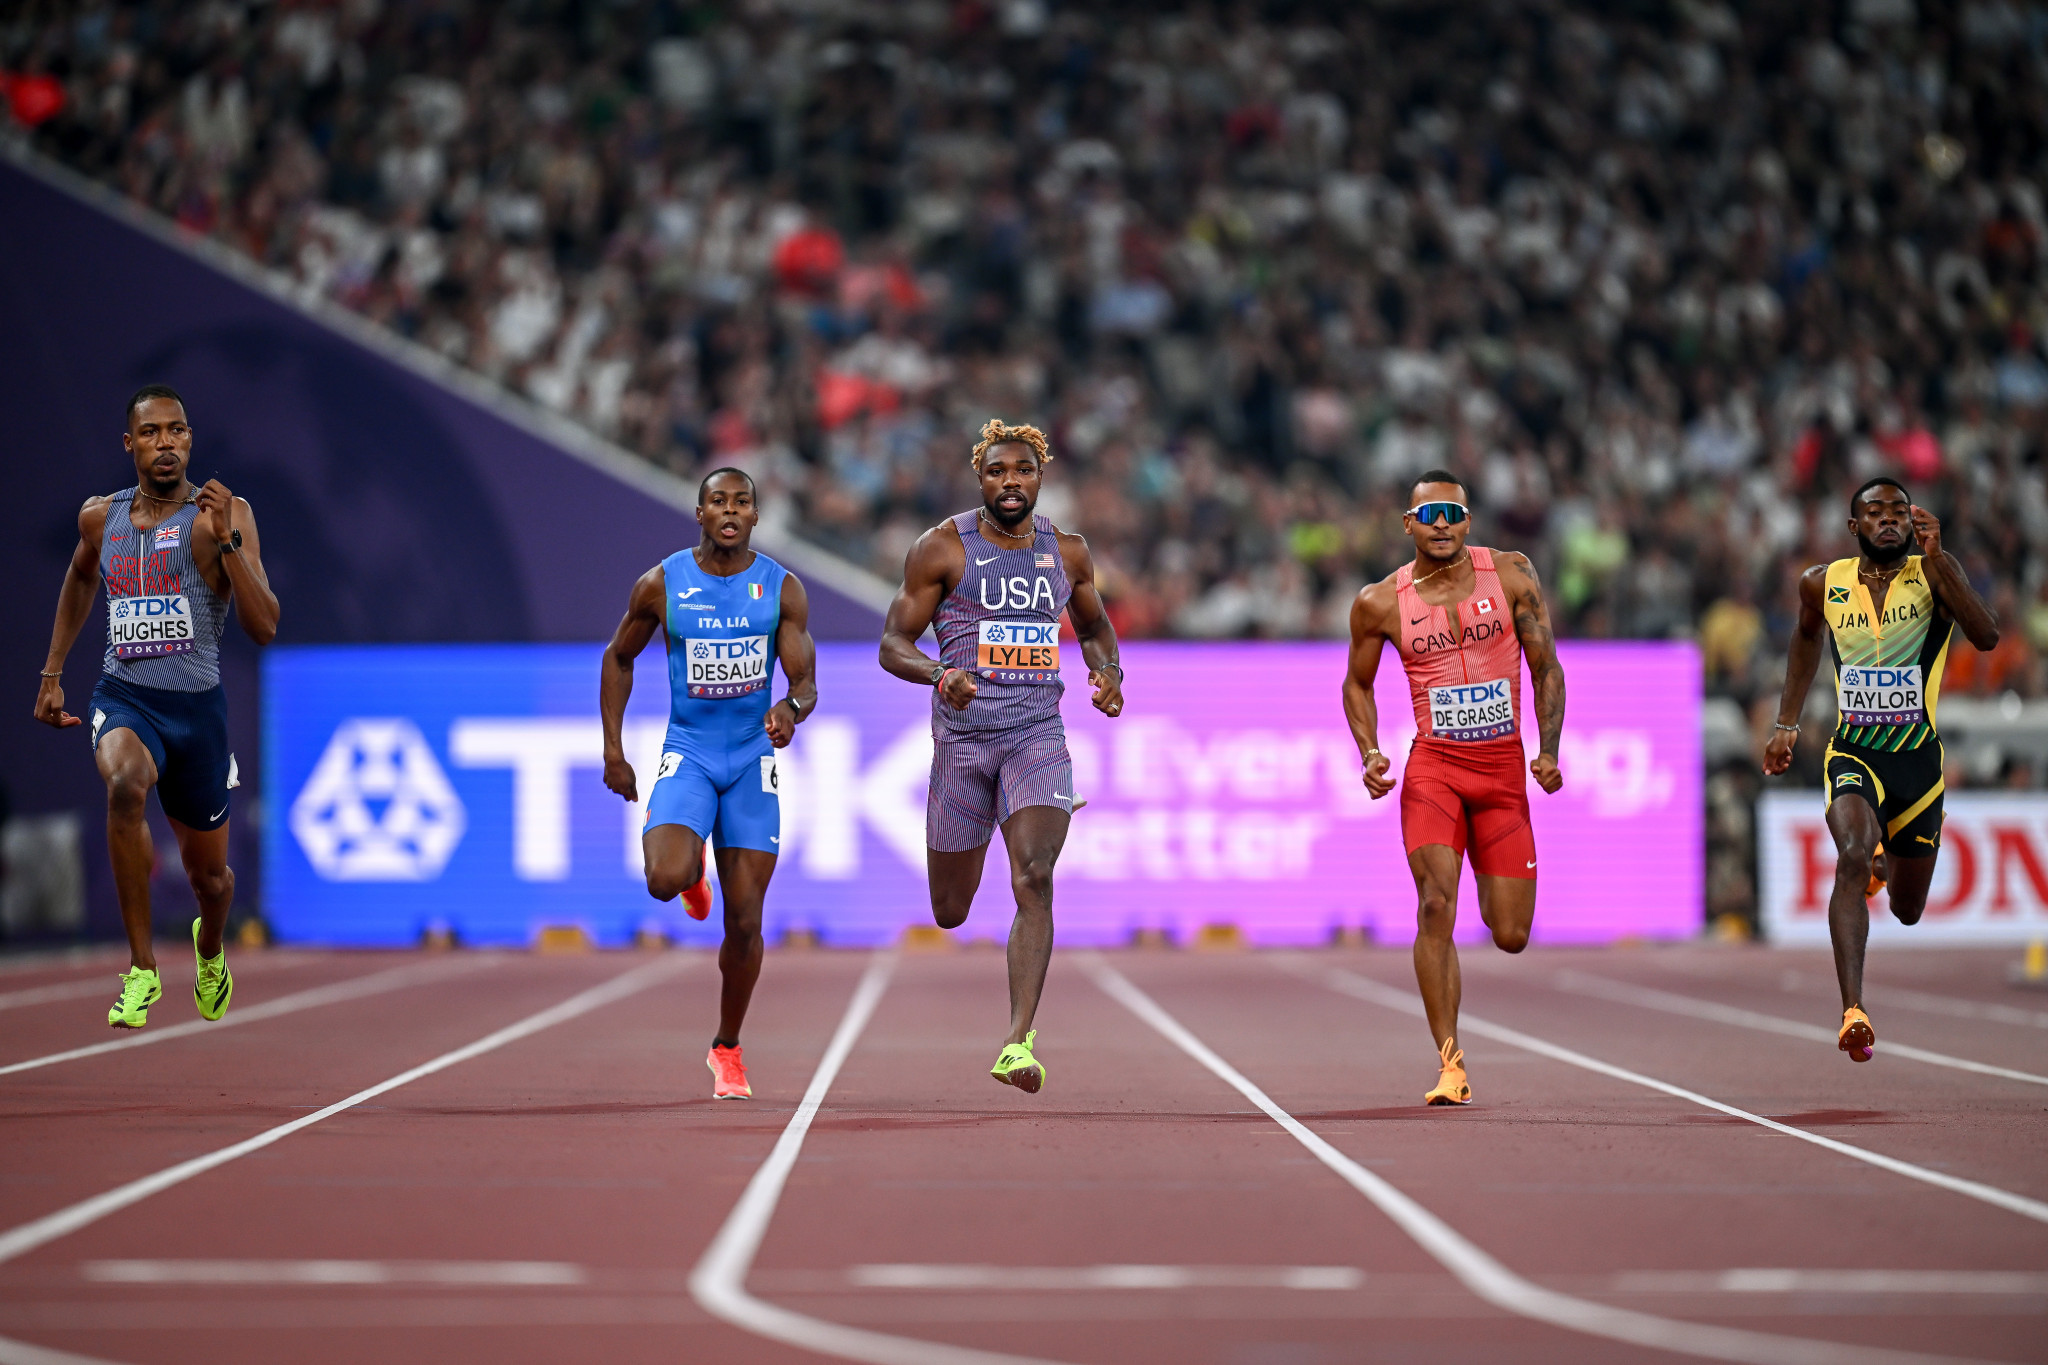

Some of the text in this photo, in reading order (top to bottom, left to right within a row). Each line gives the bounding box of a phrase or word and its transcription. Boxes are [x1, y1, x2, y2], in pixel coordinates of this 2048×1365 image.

[110, 550, 171, 575] GREAT
[107, 574, 180, 596] BRITAIN
[980, 576, 1054, 610] USA
[130, 598, 184, 616] TDK
[1838, 603, 1919, 629] JAMAICA
[113, 620, 189, 643] HUGHES
[698, 616, 750, 629] ITALIA
[1005, 625, 1054, 644] TDK
[1412, 620, 1504, 654] CANADA
[709, 639, 761, 659] TDK
[989, 647, 1053, 667] LYLES
[692, 659, 763, 681] DESALU
[1859, 669, 1915, 687] TDK
[1451, 681, 1505, 704] TDK
[1843, 690, 1918, 709] TAYLOR
[1435, 701, 1510, 727] DE GRASSE
